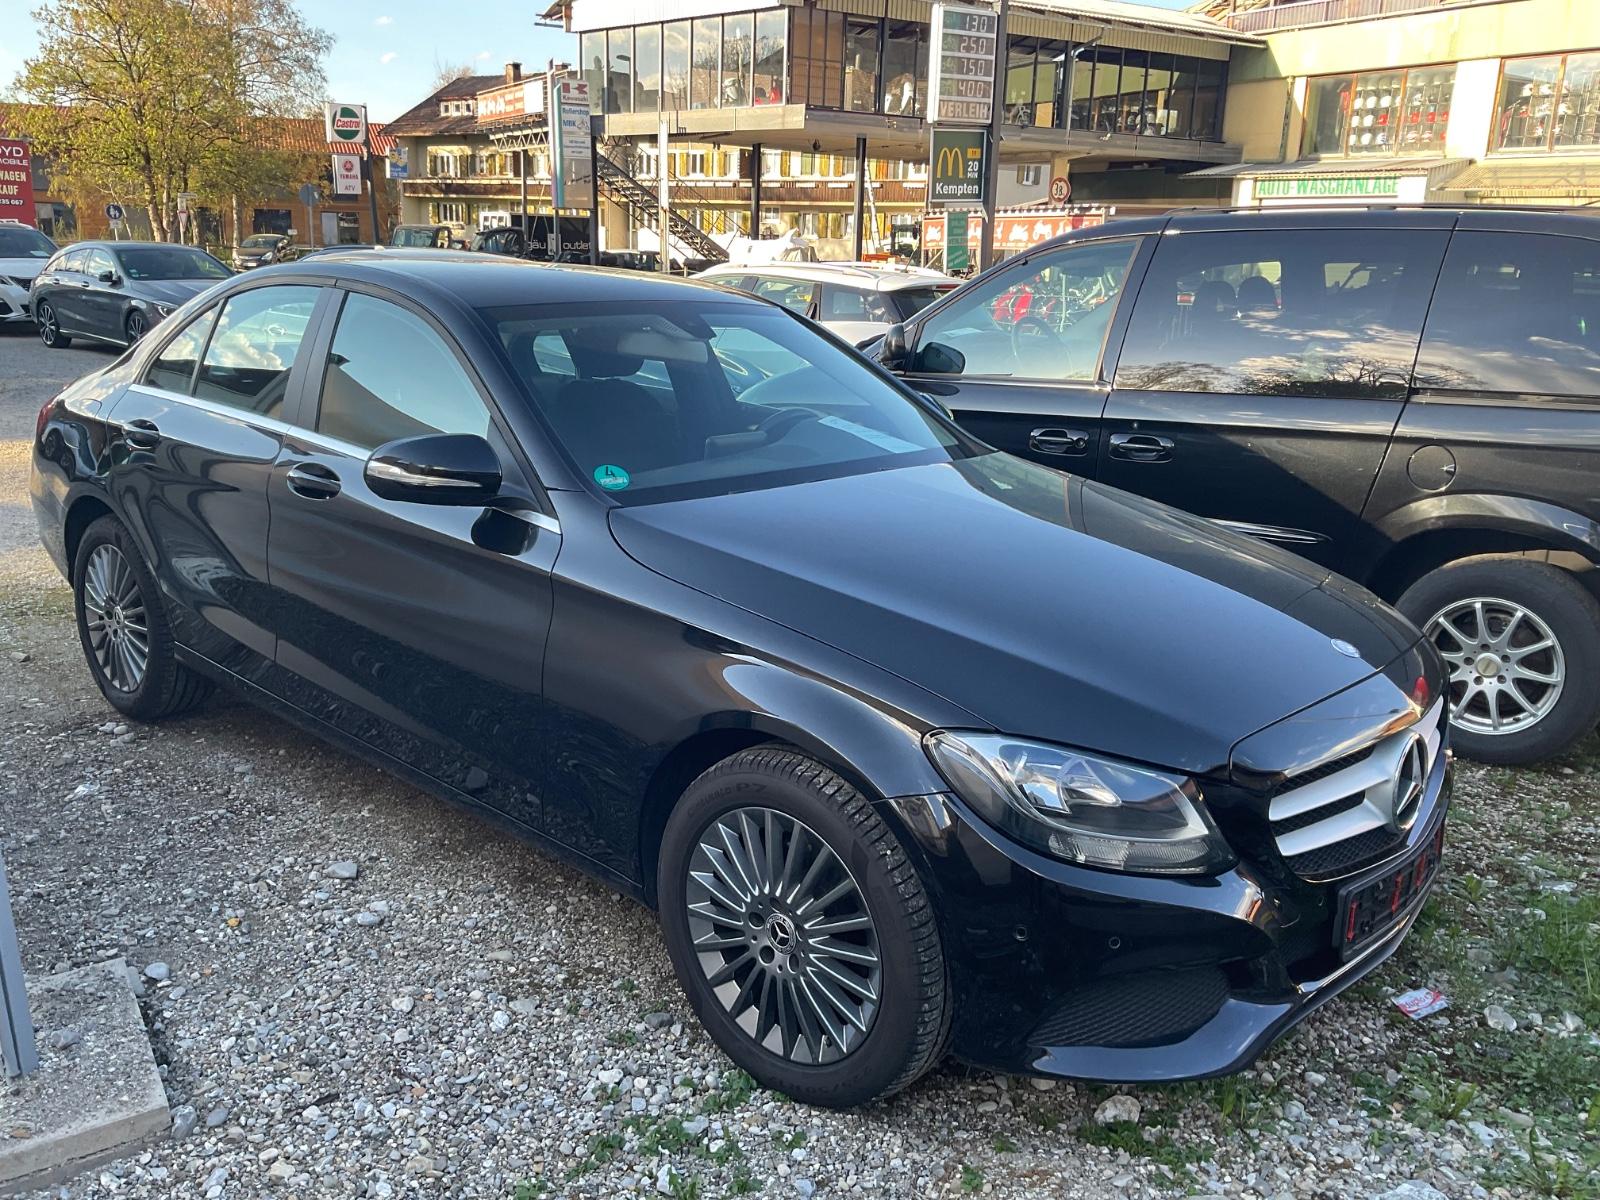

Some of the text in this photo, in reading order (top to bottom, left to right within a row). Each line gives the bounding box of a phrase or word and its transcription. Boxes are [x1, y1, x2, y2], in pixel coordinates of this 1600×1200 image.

[959, 36, 987, 55] 250
[960, 58, 985, 76] 750
[958, 80, 984, 98] 400
[939, 100, 989, 119] VERLEIH
[336, 118, 360, 129] Castrol
[967, 160, 979, 172] 20
[340, 172, 359, 180] YAMAHA
[967, 171, 979, 179] MIN
[935, 182, 979, 197] Kempten
